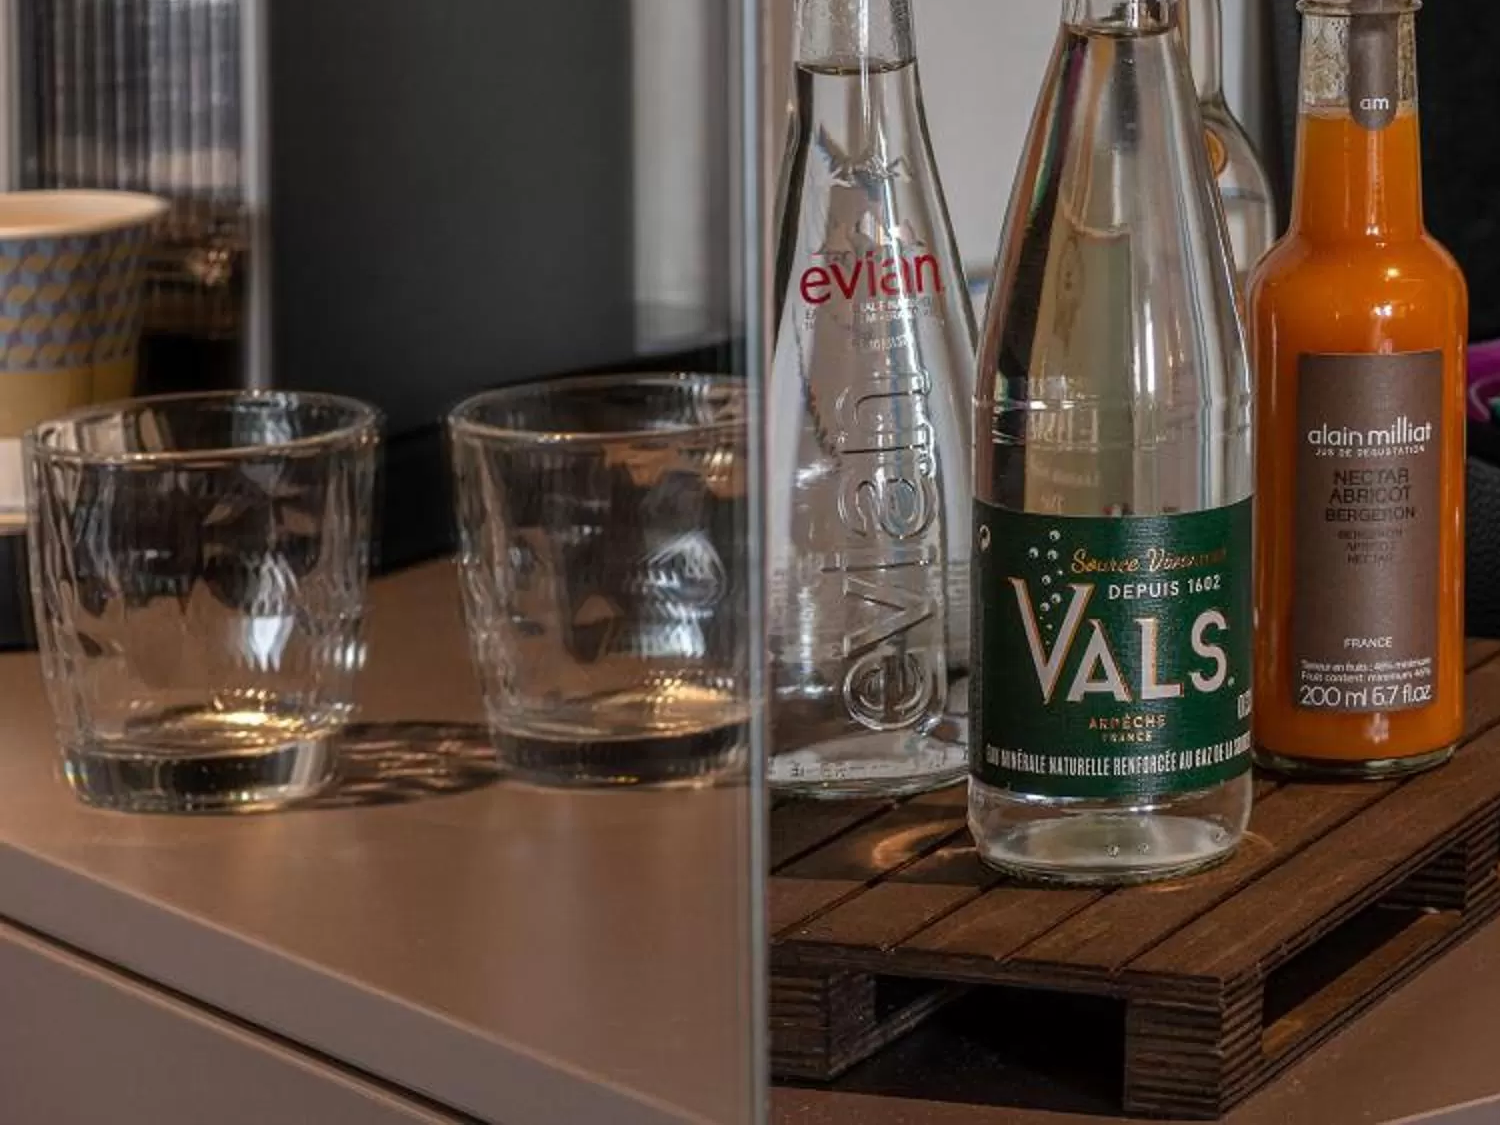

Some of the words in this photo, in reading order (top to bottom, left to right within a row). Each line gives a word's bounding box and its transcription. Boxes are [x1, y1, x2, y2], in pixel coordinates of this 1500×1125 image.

[1360, 96, 1389, 110] am
[799, 250, 944, 305] evian
[1307, 422, 1363, 446] alain
[1367, 415, 1433, 446] milliat
[1333, 467, 1409, 486] NECTAR
[1329, 485, 1412, 504] ABRICOT
[1324, 506, 1416, 523] BERGERON
[1108, 580, 1180, 600] DEPUIS
[1187, 574, 1222, 594] 1602
[1343, 636, 1393, 649] FRANCE
[1300, 685, 1342, 707] 200
[1345, 686, 1367, 708] ml
[1001, 748, 1046, 774] MINÉRALE
[1049, 756, 1109, 776] NATURELLE
[1113, 750, 1177, 776] RENFORCÉE
[1179, 752, 1193, 771] AU
